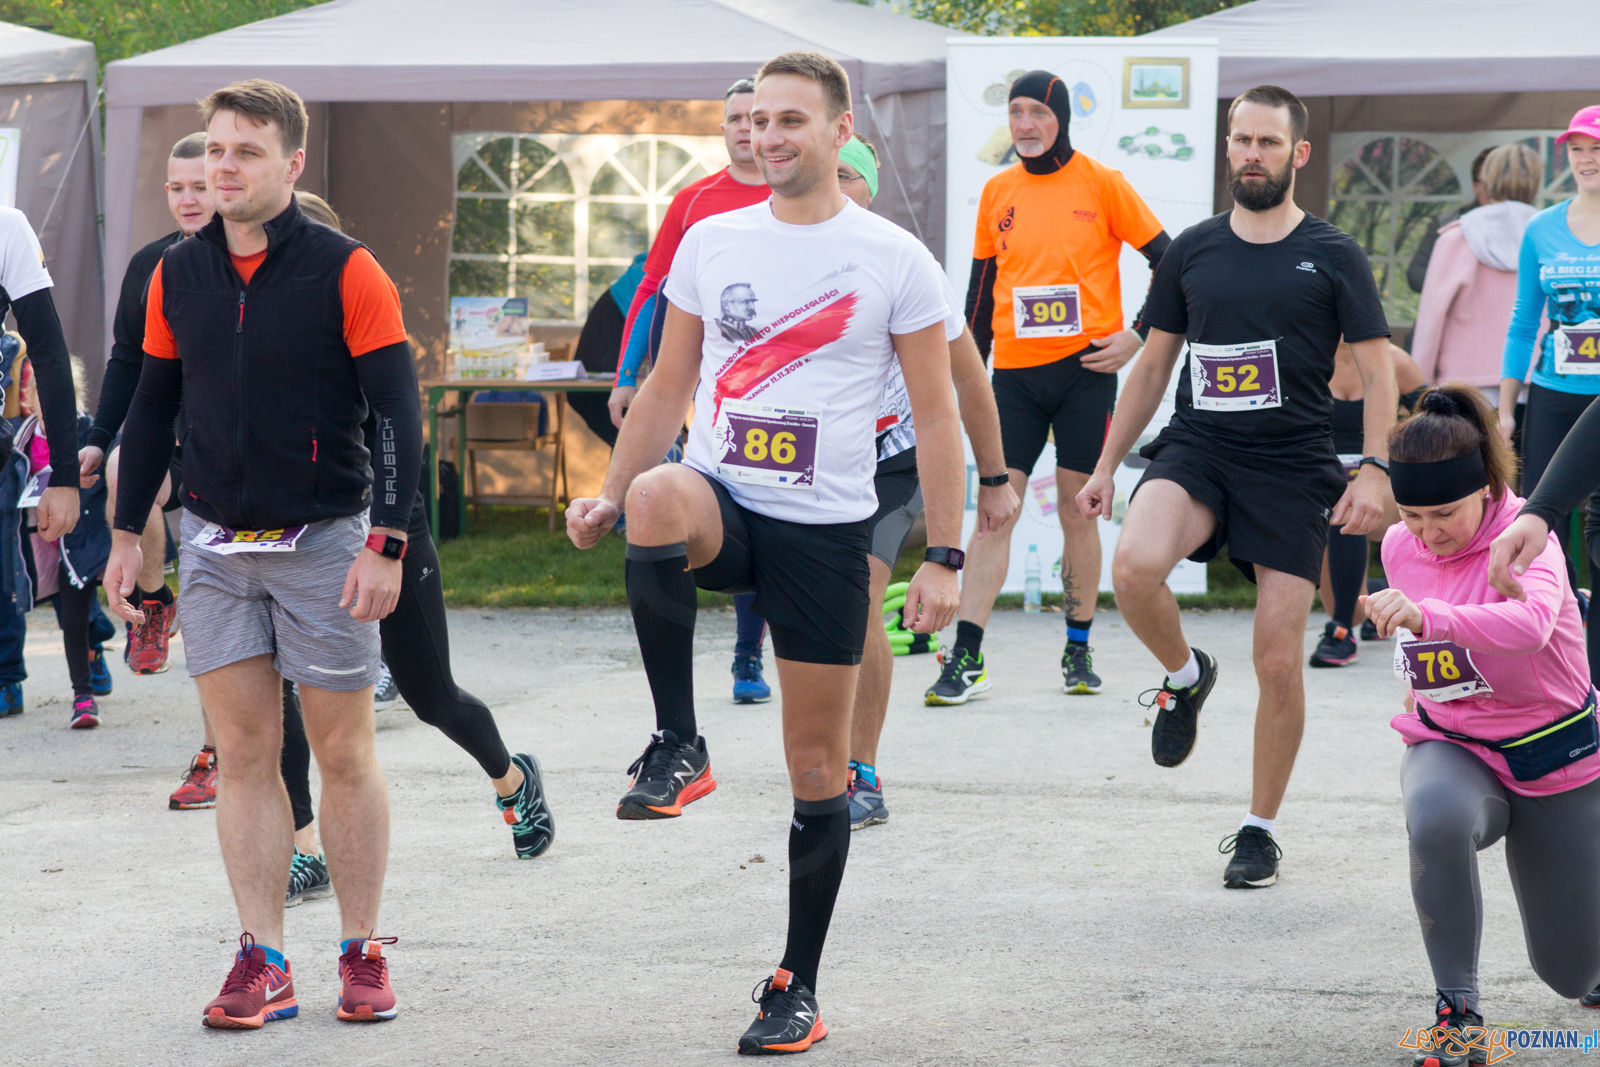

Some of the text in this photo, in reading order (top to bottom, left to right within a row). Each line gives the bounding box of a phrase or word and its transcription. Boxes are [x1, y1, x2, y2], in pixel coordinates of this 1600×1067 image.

[1557, 266, 1585, 274] BIEG
[771, 288, 840, 329] NIEPODLEGŁOŚCI
[1032, 301, 1067, 323] 90
[1578, 336, 1600, 359] 4
[743, 382, 770, 401] OLENIÓW
[770, 360, 804, 384] 11.11.2016
[1216, 364, 1260, 392] 52
[382, 416, 397, 505] BRUBECK
[744, 428, 797, 464] 86
[232, 528, 284, 543] 85
[1418, 650, 1460, 682] 78
